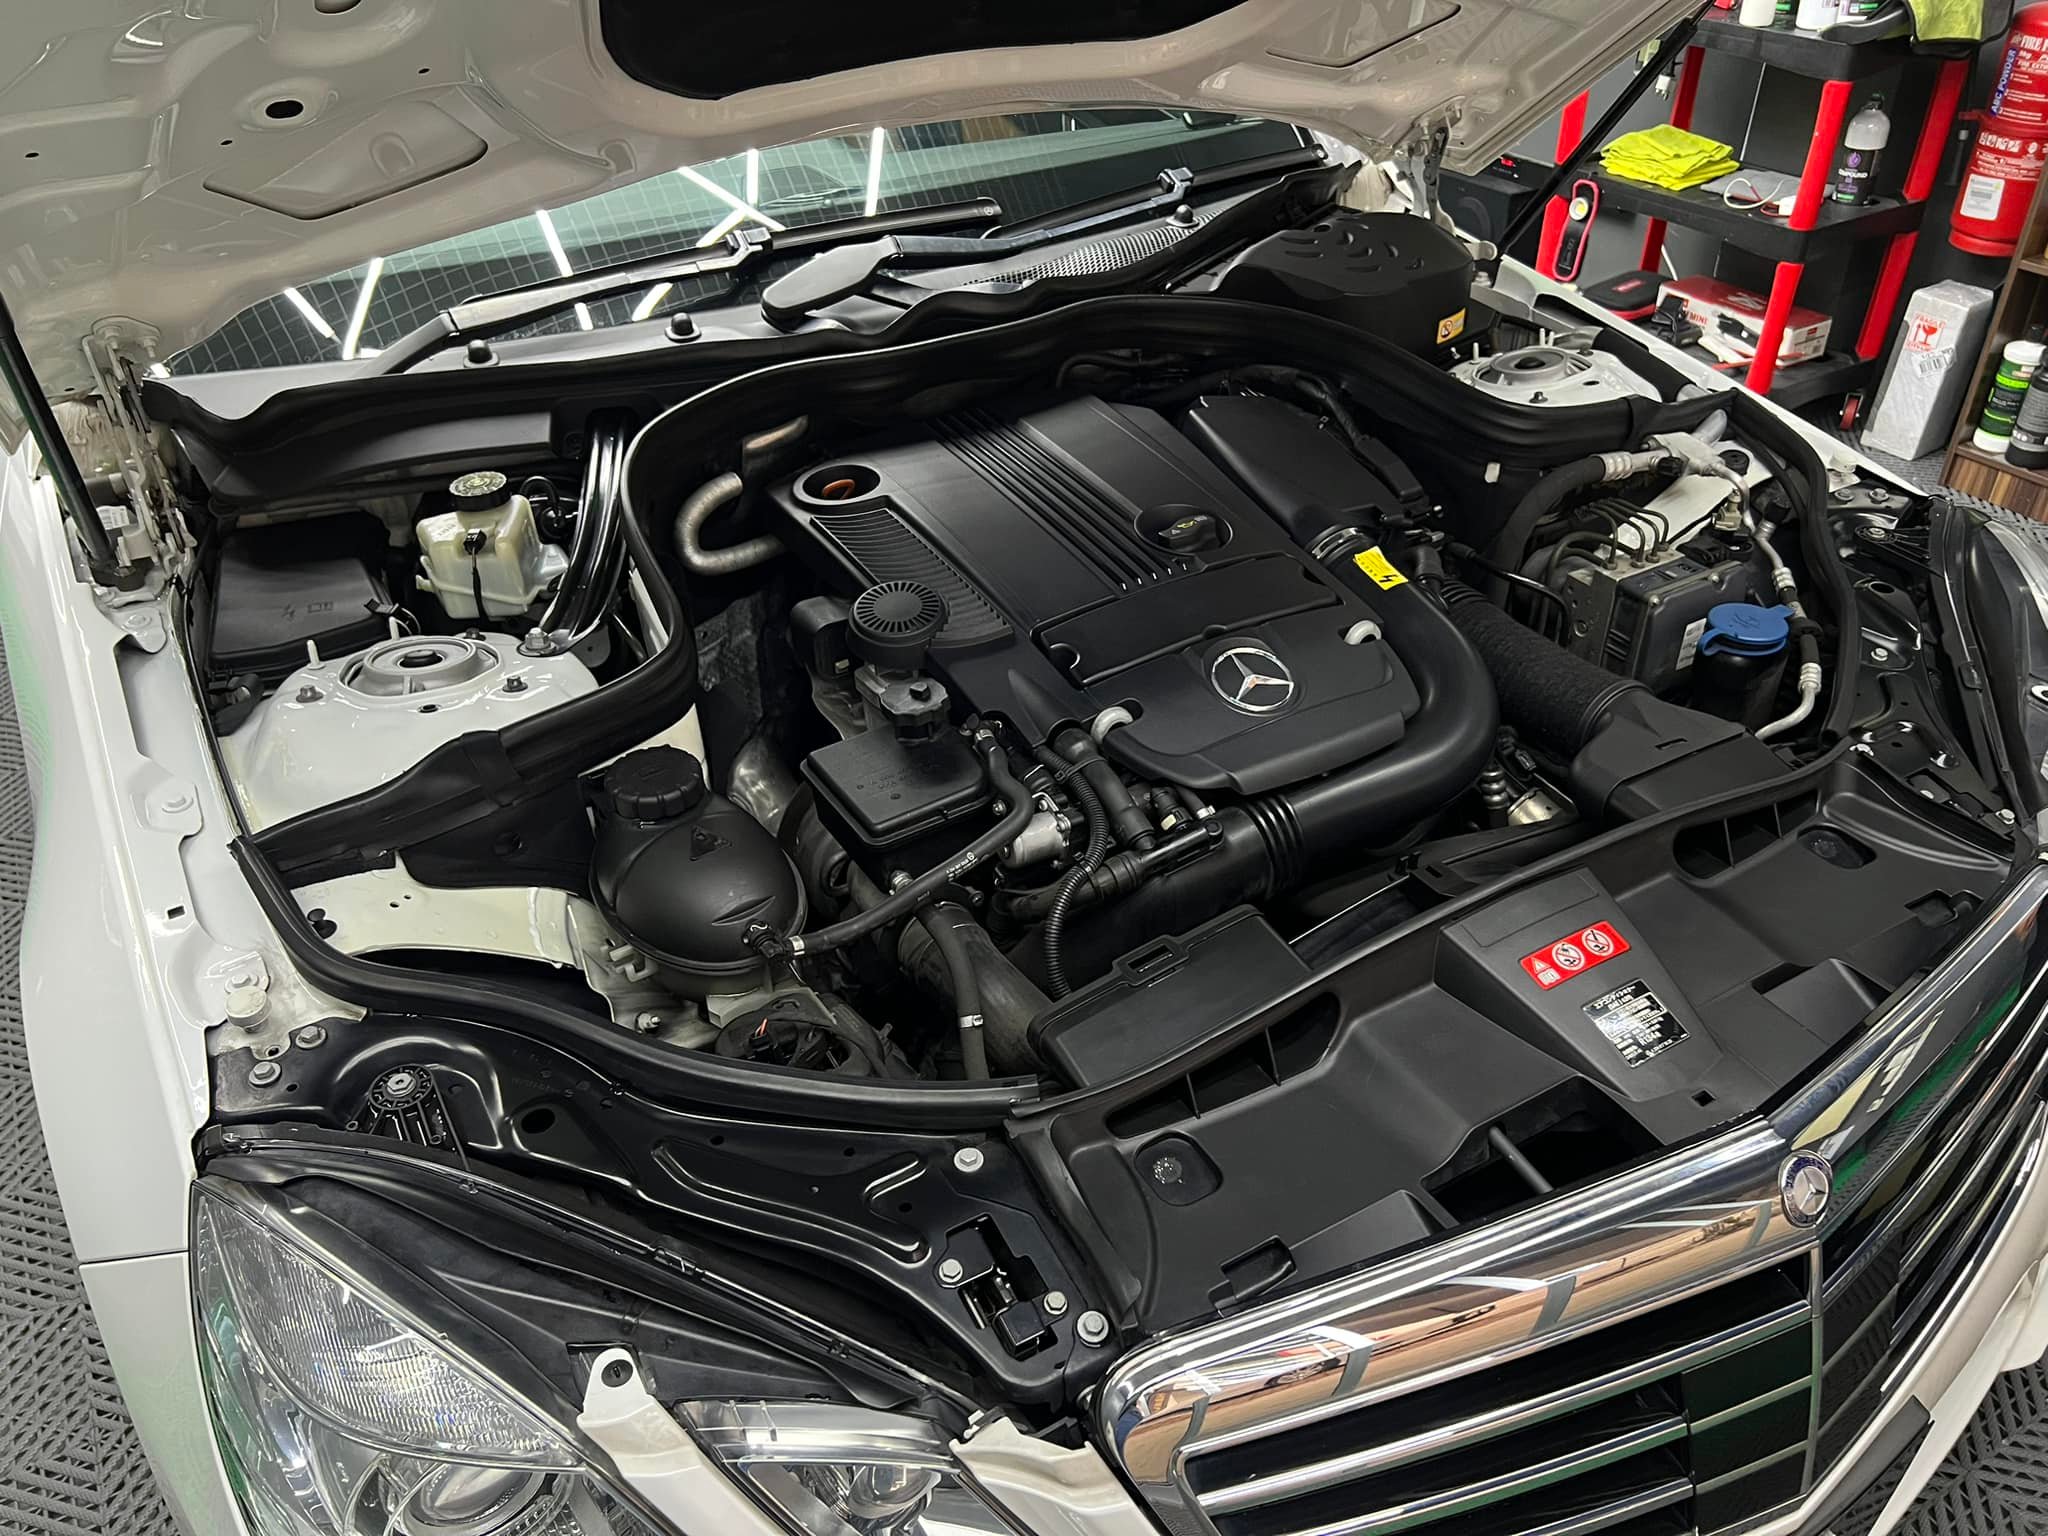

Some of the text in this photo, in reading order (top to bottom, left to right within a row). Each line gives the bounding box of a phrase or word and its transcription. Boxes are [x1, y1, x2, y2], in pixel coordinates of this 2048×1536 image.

[2020, 35, 2043, 51] FIRE
[1991, 49, 2017, 114] ABC POWDER
[1689, 313, 1709, 325] MINI
[1636, 1031, 1662, 1047] R134a
